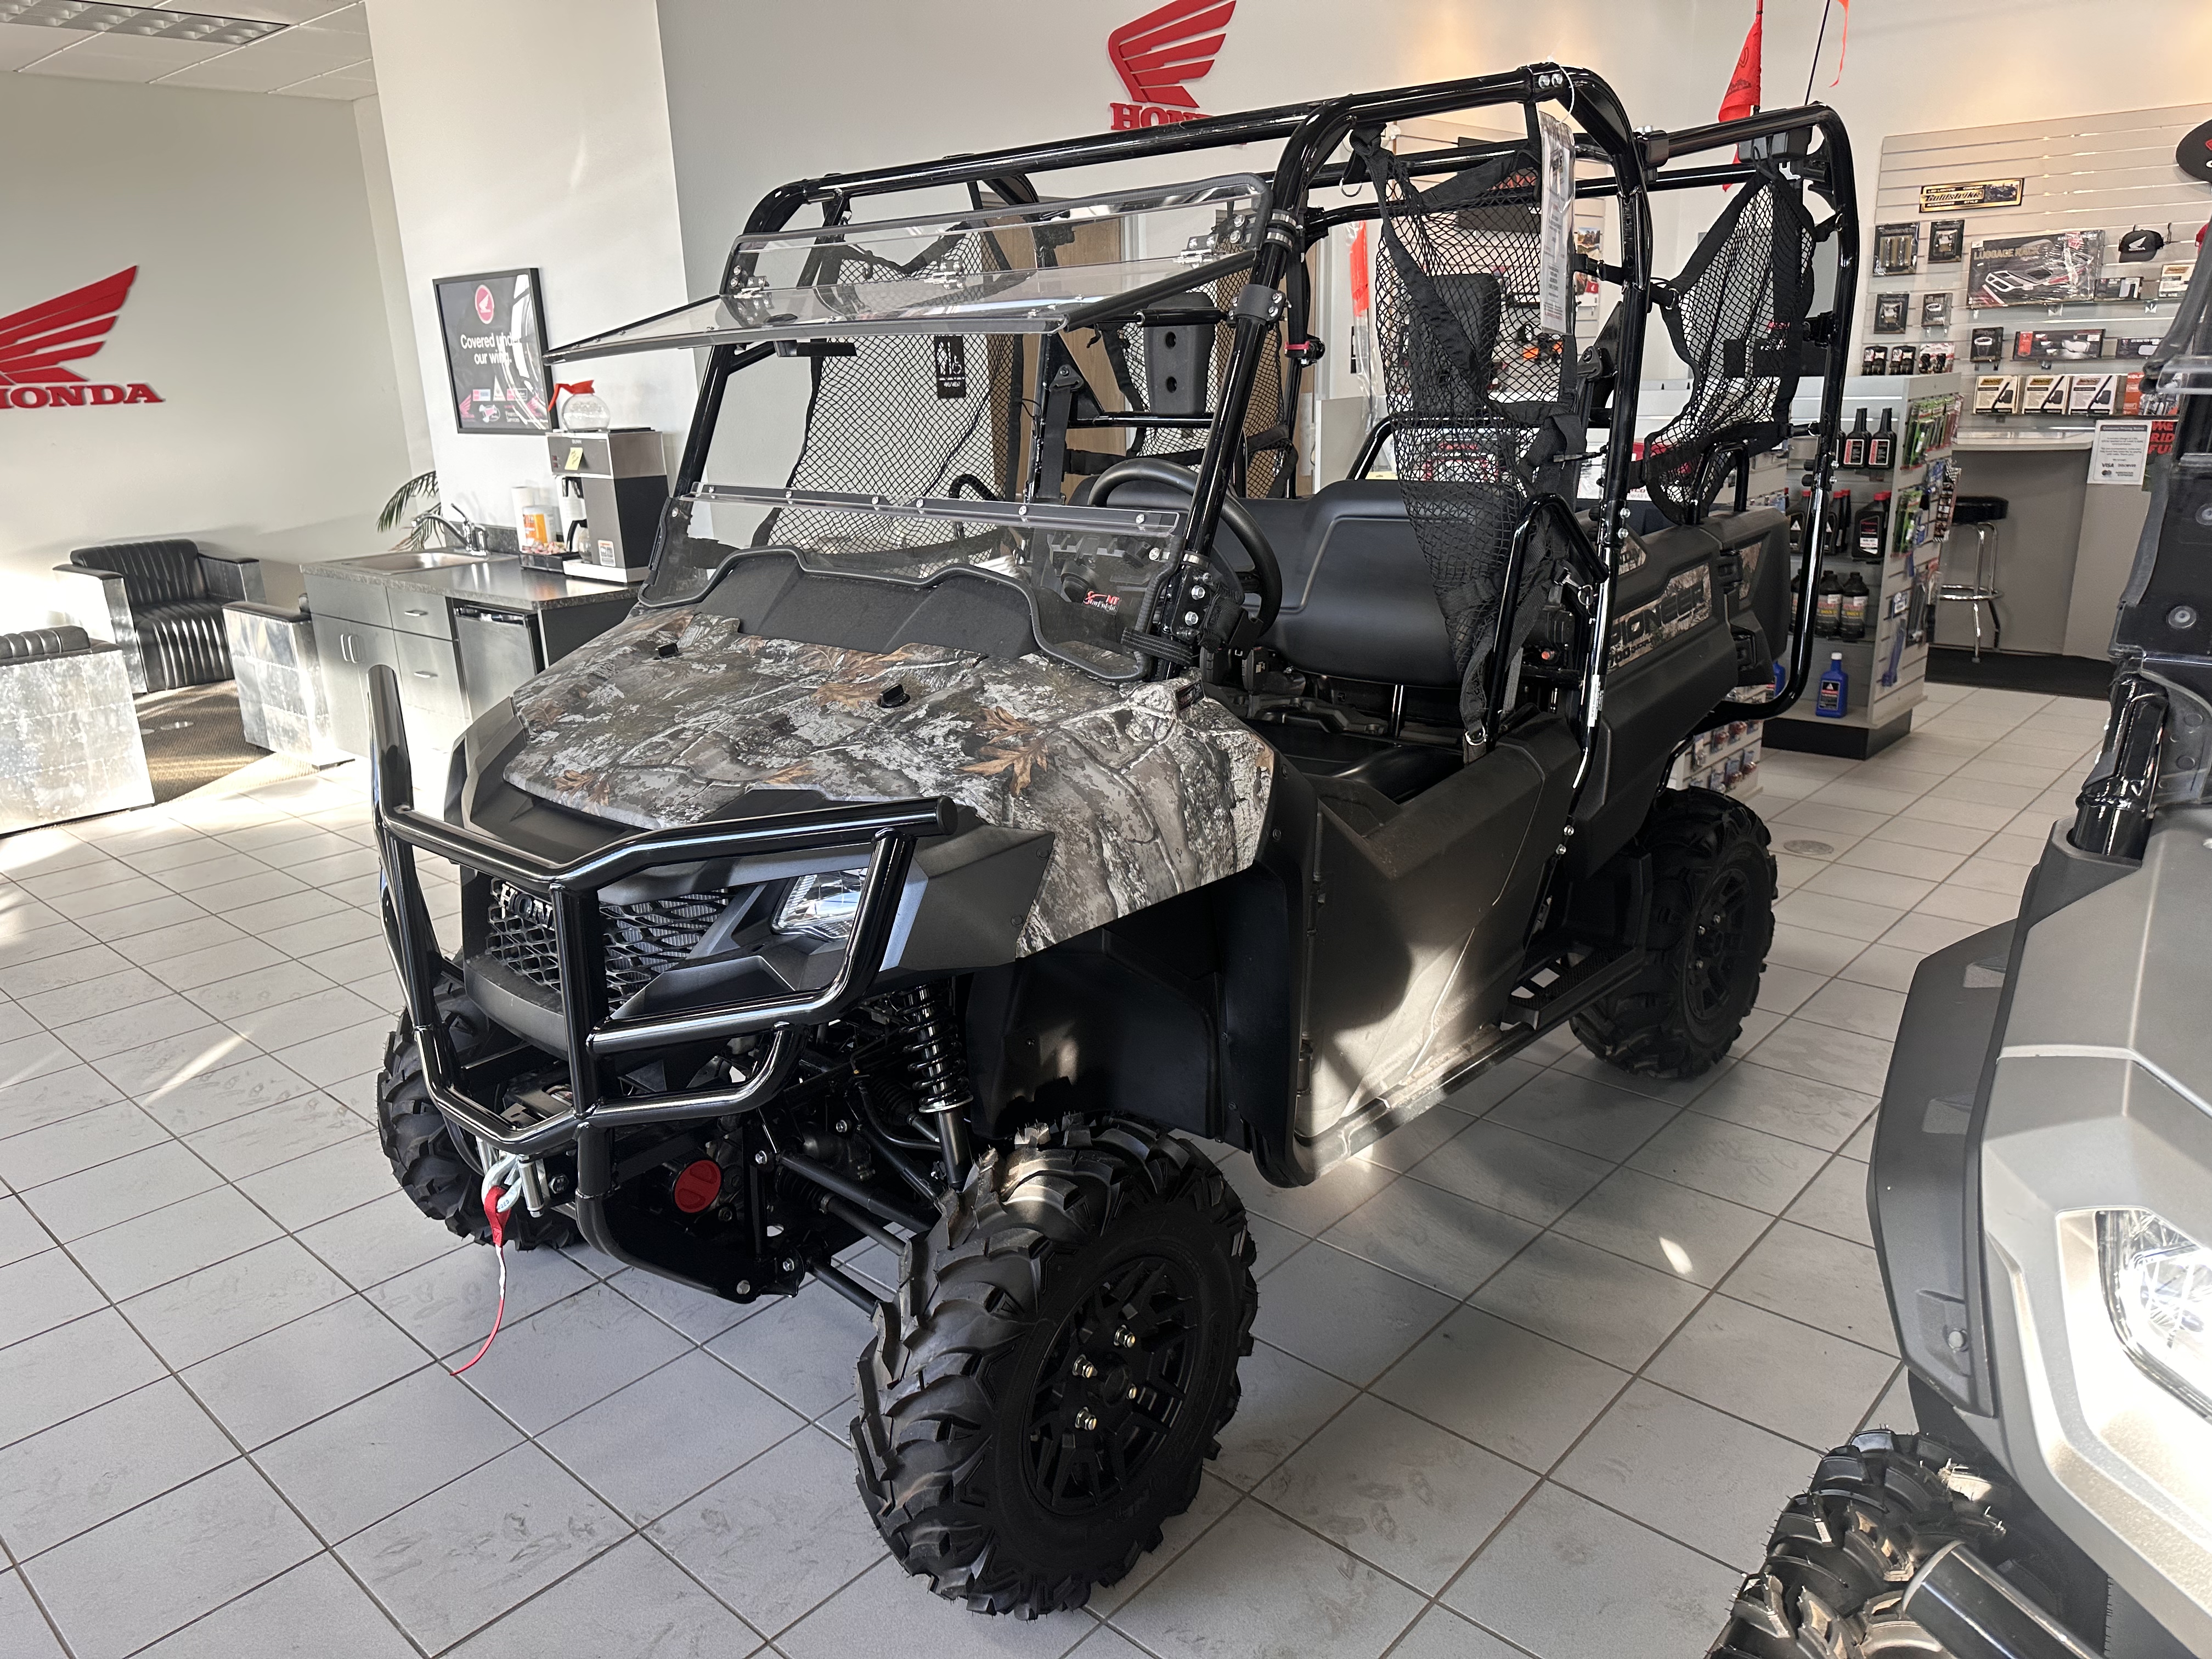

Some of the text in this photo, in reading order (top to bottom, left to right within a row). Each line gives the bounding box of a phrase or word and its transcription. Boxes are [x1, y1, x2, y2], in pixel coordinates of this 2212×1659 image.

[460, 332, 495, 349] Covered
[474, 353, 488, 365] our
[2152, 421, 2174, 431] WE
[500, 883, 556, 932] HON
